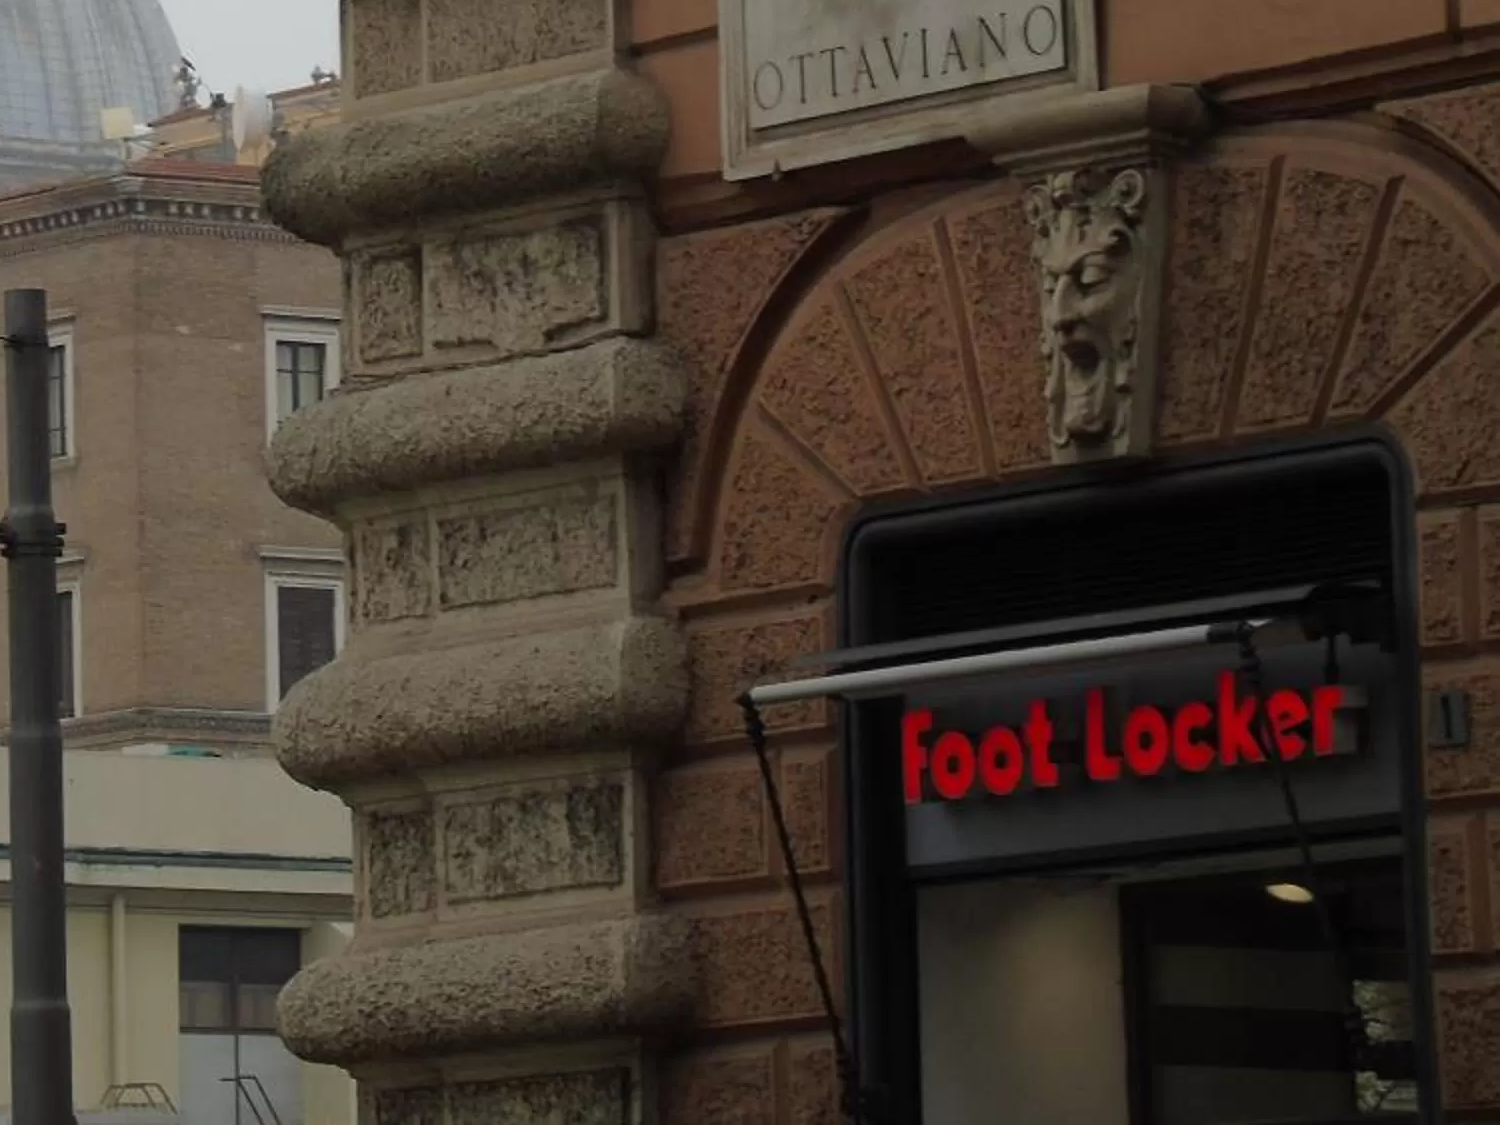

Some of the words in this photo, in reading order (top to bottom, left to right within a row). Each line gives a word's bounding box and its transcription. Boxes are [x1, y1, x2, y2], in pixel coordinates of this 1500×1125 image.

[753, 4, 1057, 111] OTTAVIANO
[902, 698, 1060, 805] Foot
[1085, 668, 1346, 781] Locker
